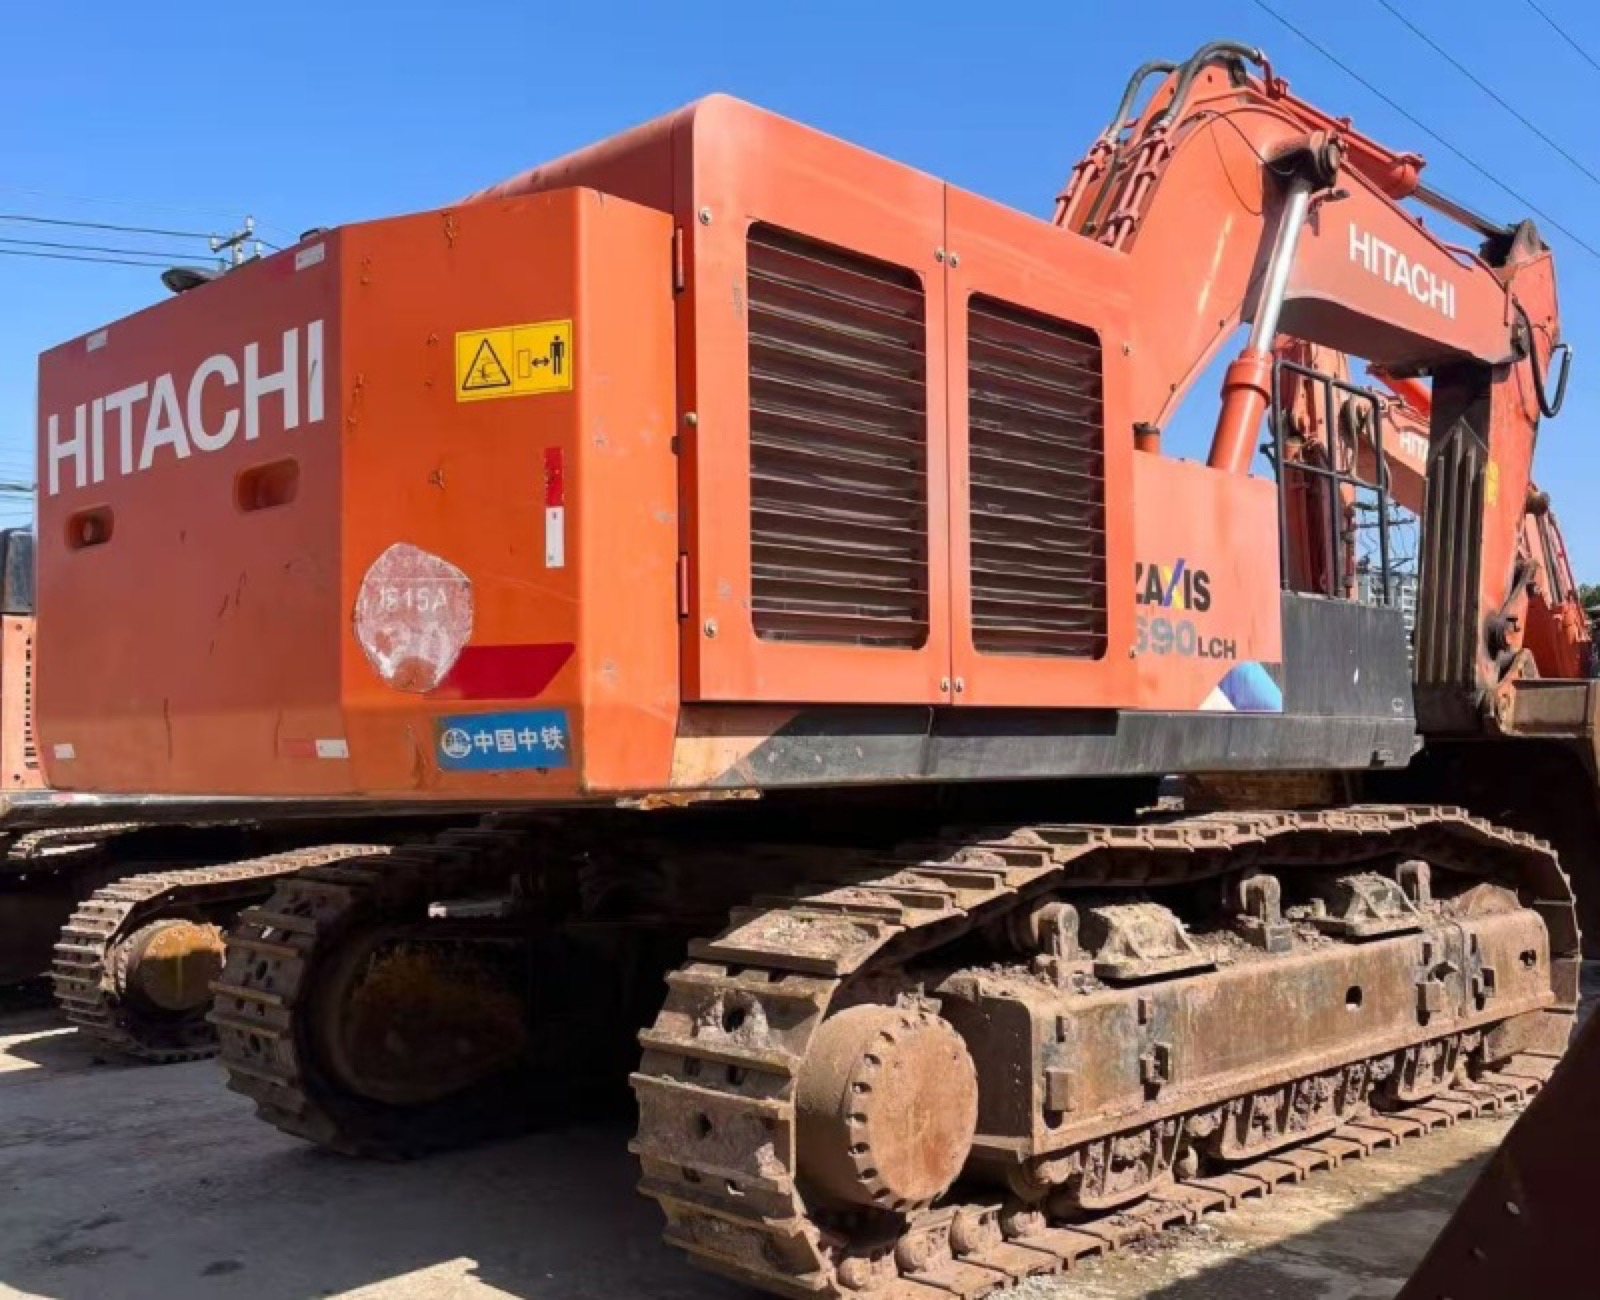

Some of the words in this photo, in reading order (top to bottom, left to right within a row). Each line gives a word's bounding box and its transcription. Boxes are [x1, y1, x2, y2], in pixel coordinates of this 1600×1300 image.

[1349, 222, 1455, 319] HITACHI
[48, 319, 325, 496] HITACHI
[473, 726, 565, 755] 中国中铁
